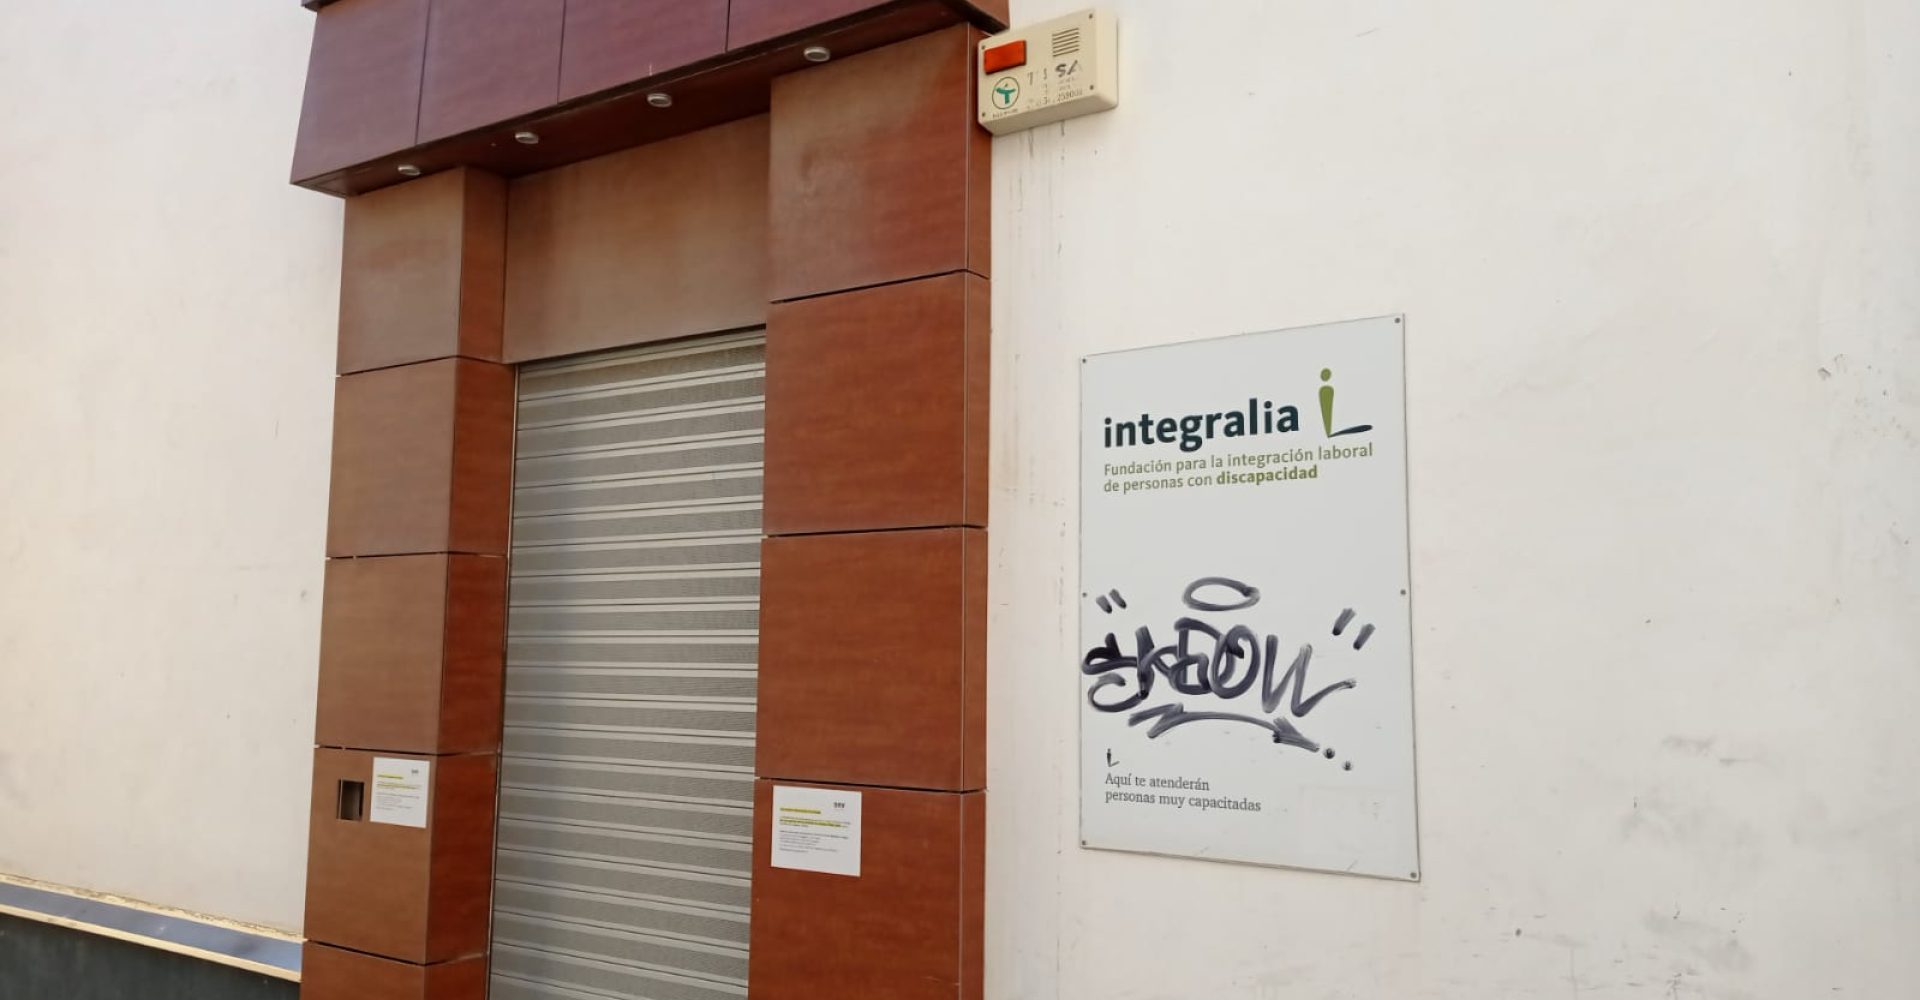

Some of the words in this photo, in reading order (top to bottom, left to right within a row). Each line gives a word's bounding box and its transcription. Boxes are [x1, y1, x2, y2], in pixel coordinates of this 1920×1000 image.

[1104, 397, 1300, 453] integralia
[1104, 460, 1172, 477] Fundación
[1176, 459, 1207, 473] para
[1211, 455, 1223, 468] la
[1227, 448, 1314, 469] integración
[1318, 442, 1373, 461] laboral
[1104, 480, 1120, 493] de
[1123, 476, 1184, 495] personas
[1187, 475, 1213, 487] con
[1216, 465, 1318, 487] discapacidad
[1105, 773, 1132, 787] Aquí
[1135, 776, 1146, 787] te
[1149, 777, 1210, 791] atenderán
[1105, 790, 1156, 804] personas
[1159, 795, 1186, 809] muy
[1188, 797, 1262, 812] capacitadas
